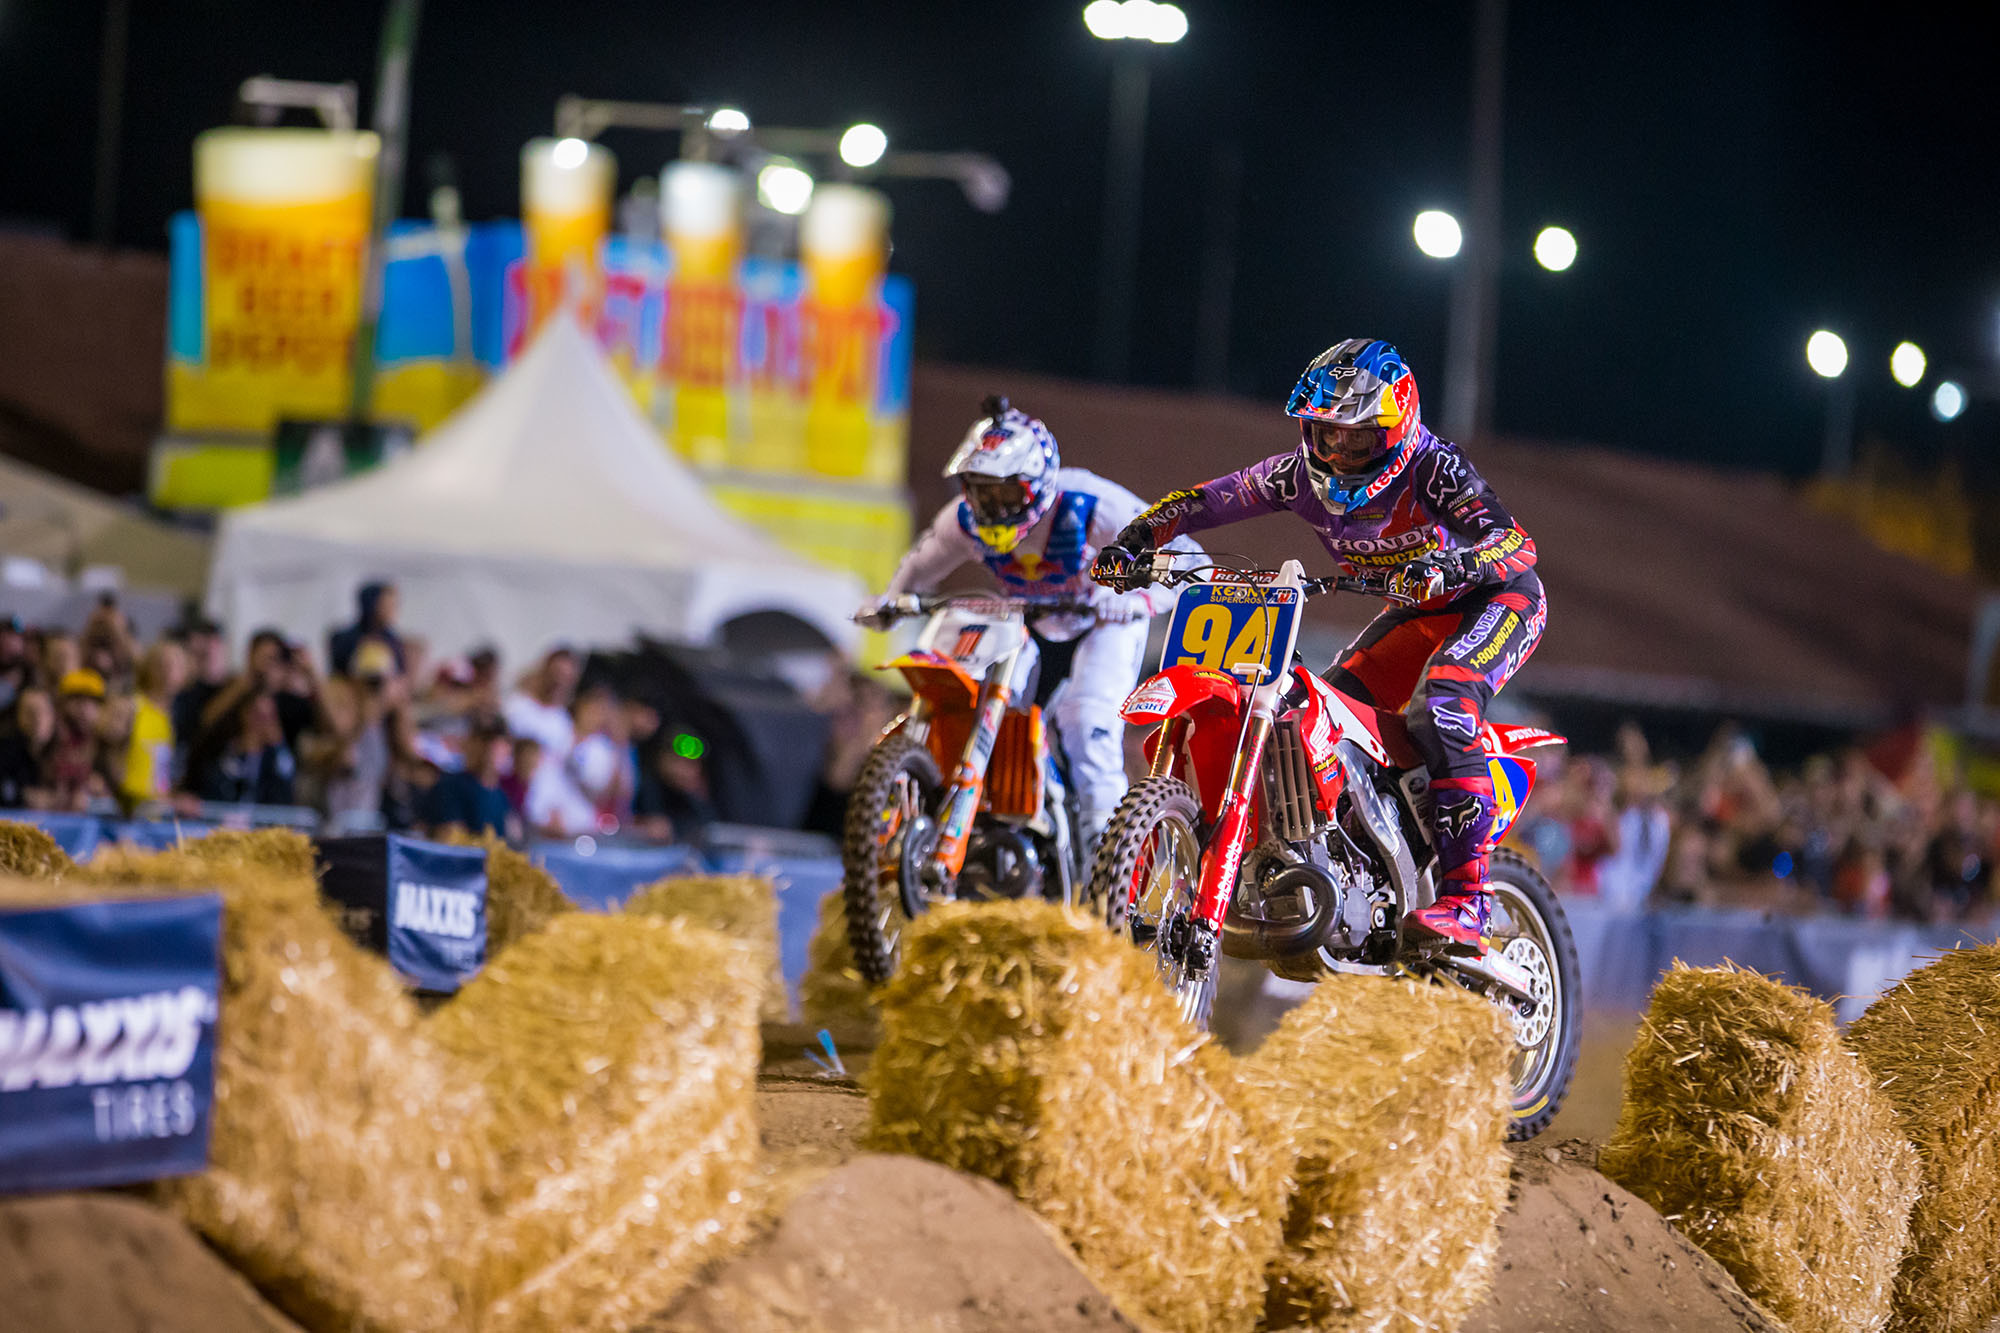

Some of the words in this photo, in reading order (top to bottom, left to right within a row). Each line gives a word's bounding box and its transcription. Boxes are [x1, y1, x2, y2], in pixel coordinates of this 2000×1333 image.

[1209, 595, 1267, 604] SUPERCROS
[1211, 586, 1270, 597] KENY
[1176, 604, 1280, 684] 94
[394, 881, 479, 940] MAXXIS
[92, 1079, 197, 1142] TIRES
